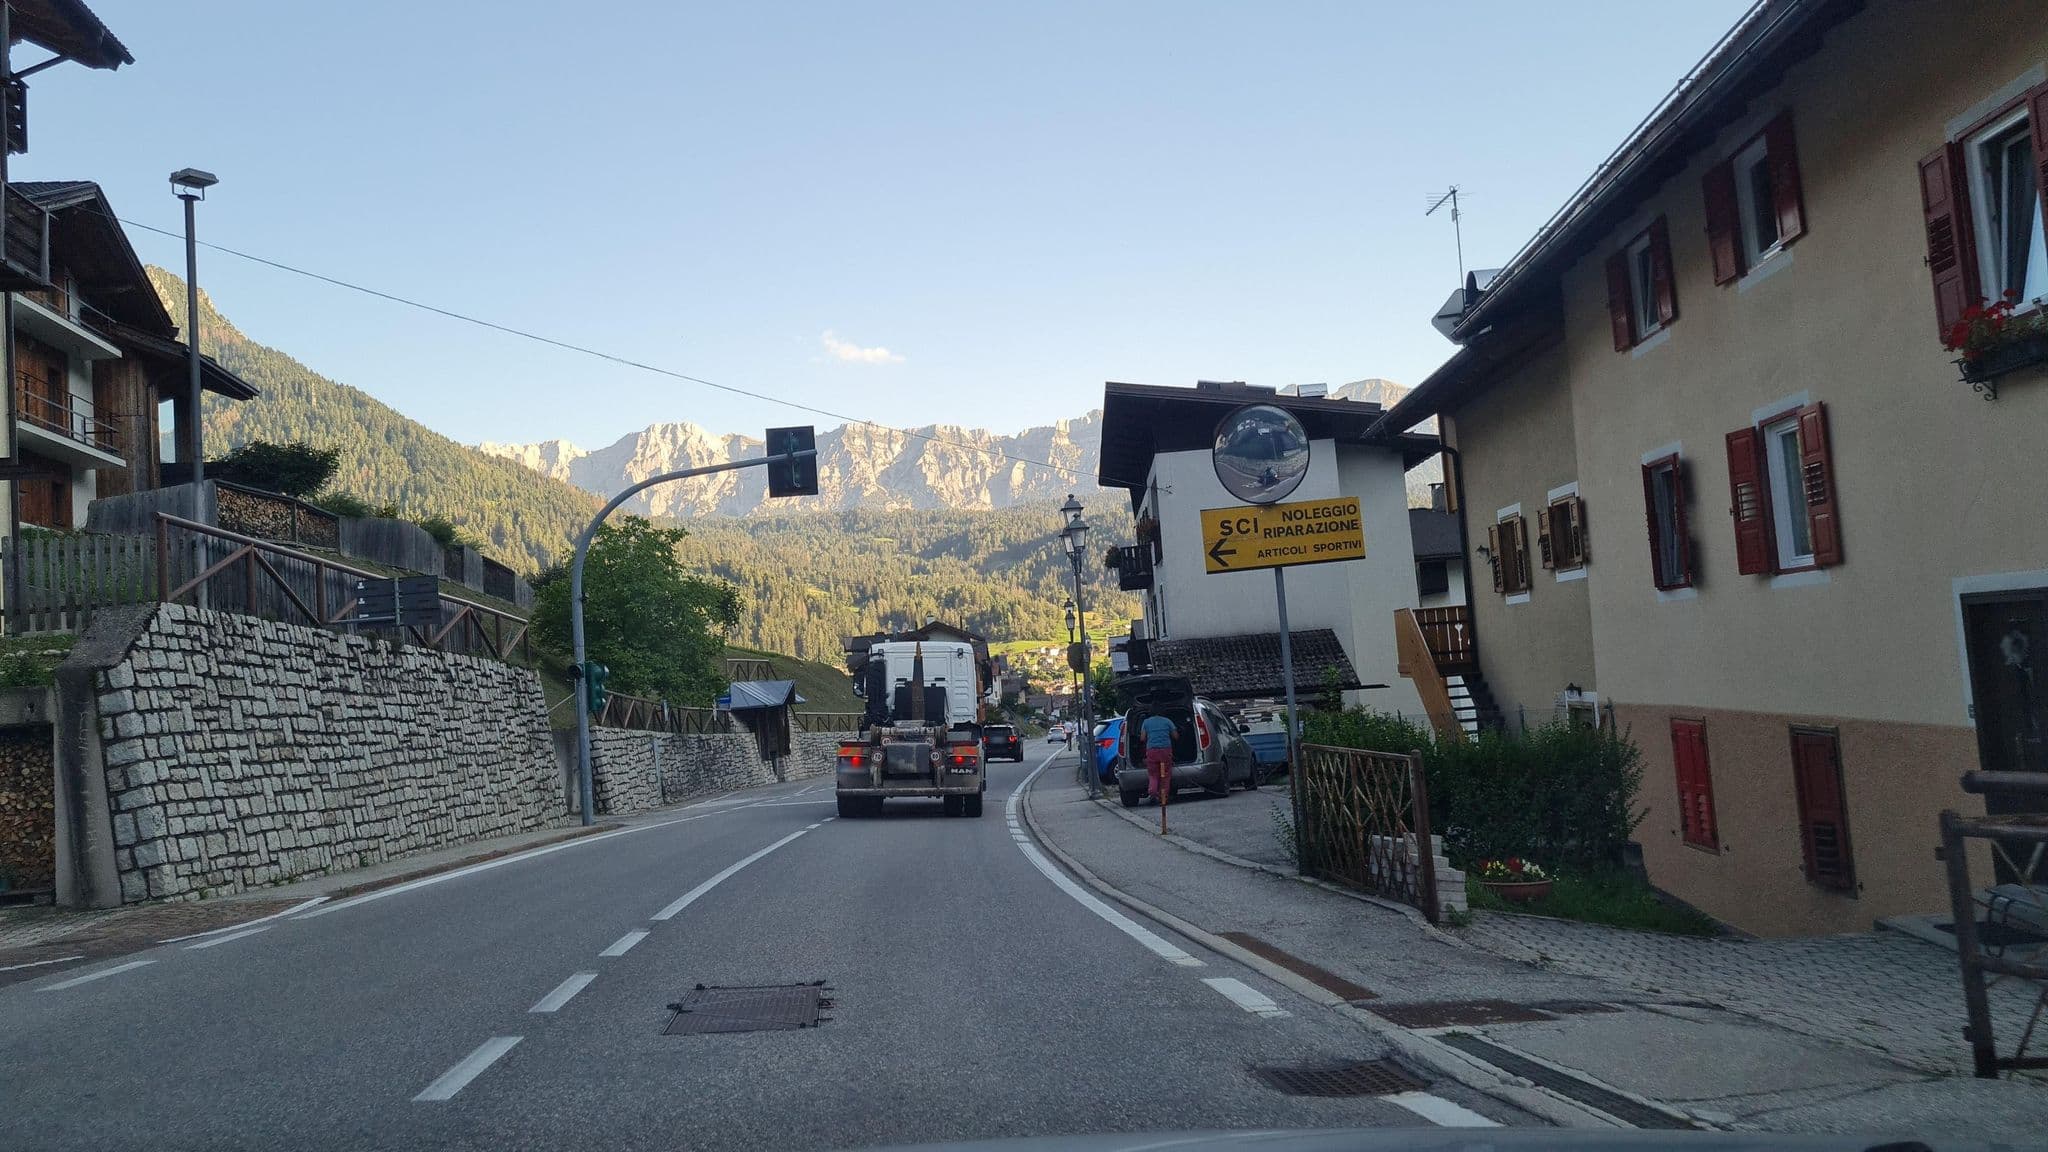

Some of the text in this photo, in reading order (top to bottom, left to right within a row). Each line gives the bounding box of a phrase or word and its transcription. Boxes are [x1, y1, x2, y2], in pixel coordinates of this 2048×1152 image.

[1282, 504, 1357, 522] NOLEGGIO
[1220, 517, 1259, 536] SCI
[1263, 519, 1359, 538] RIPARAZIONE
[1257, 540, 1362, 559] ARTICOLI SPORTIVI
